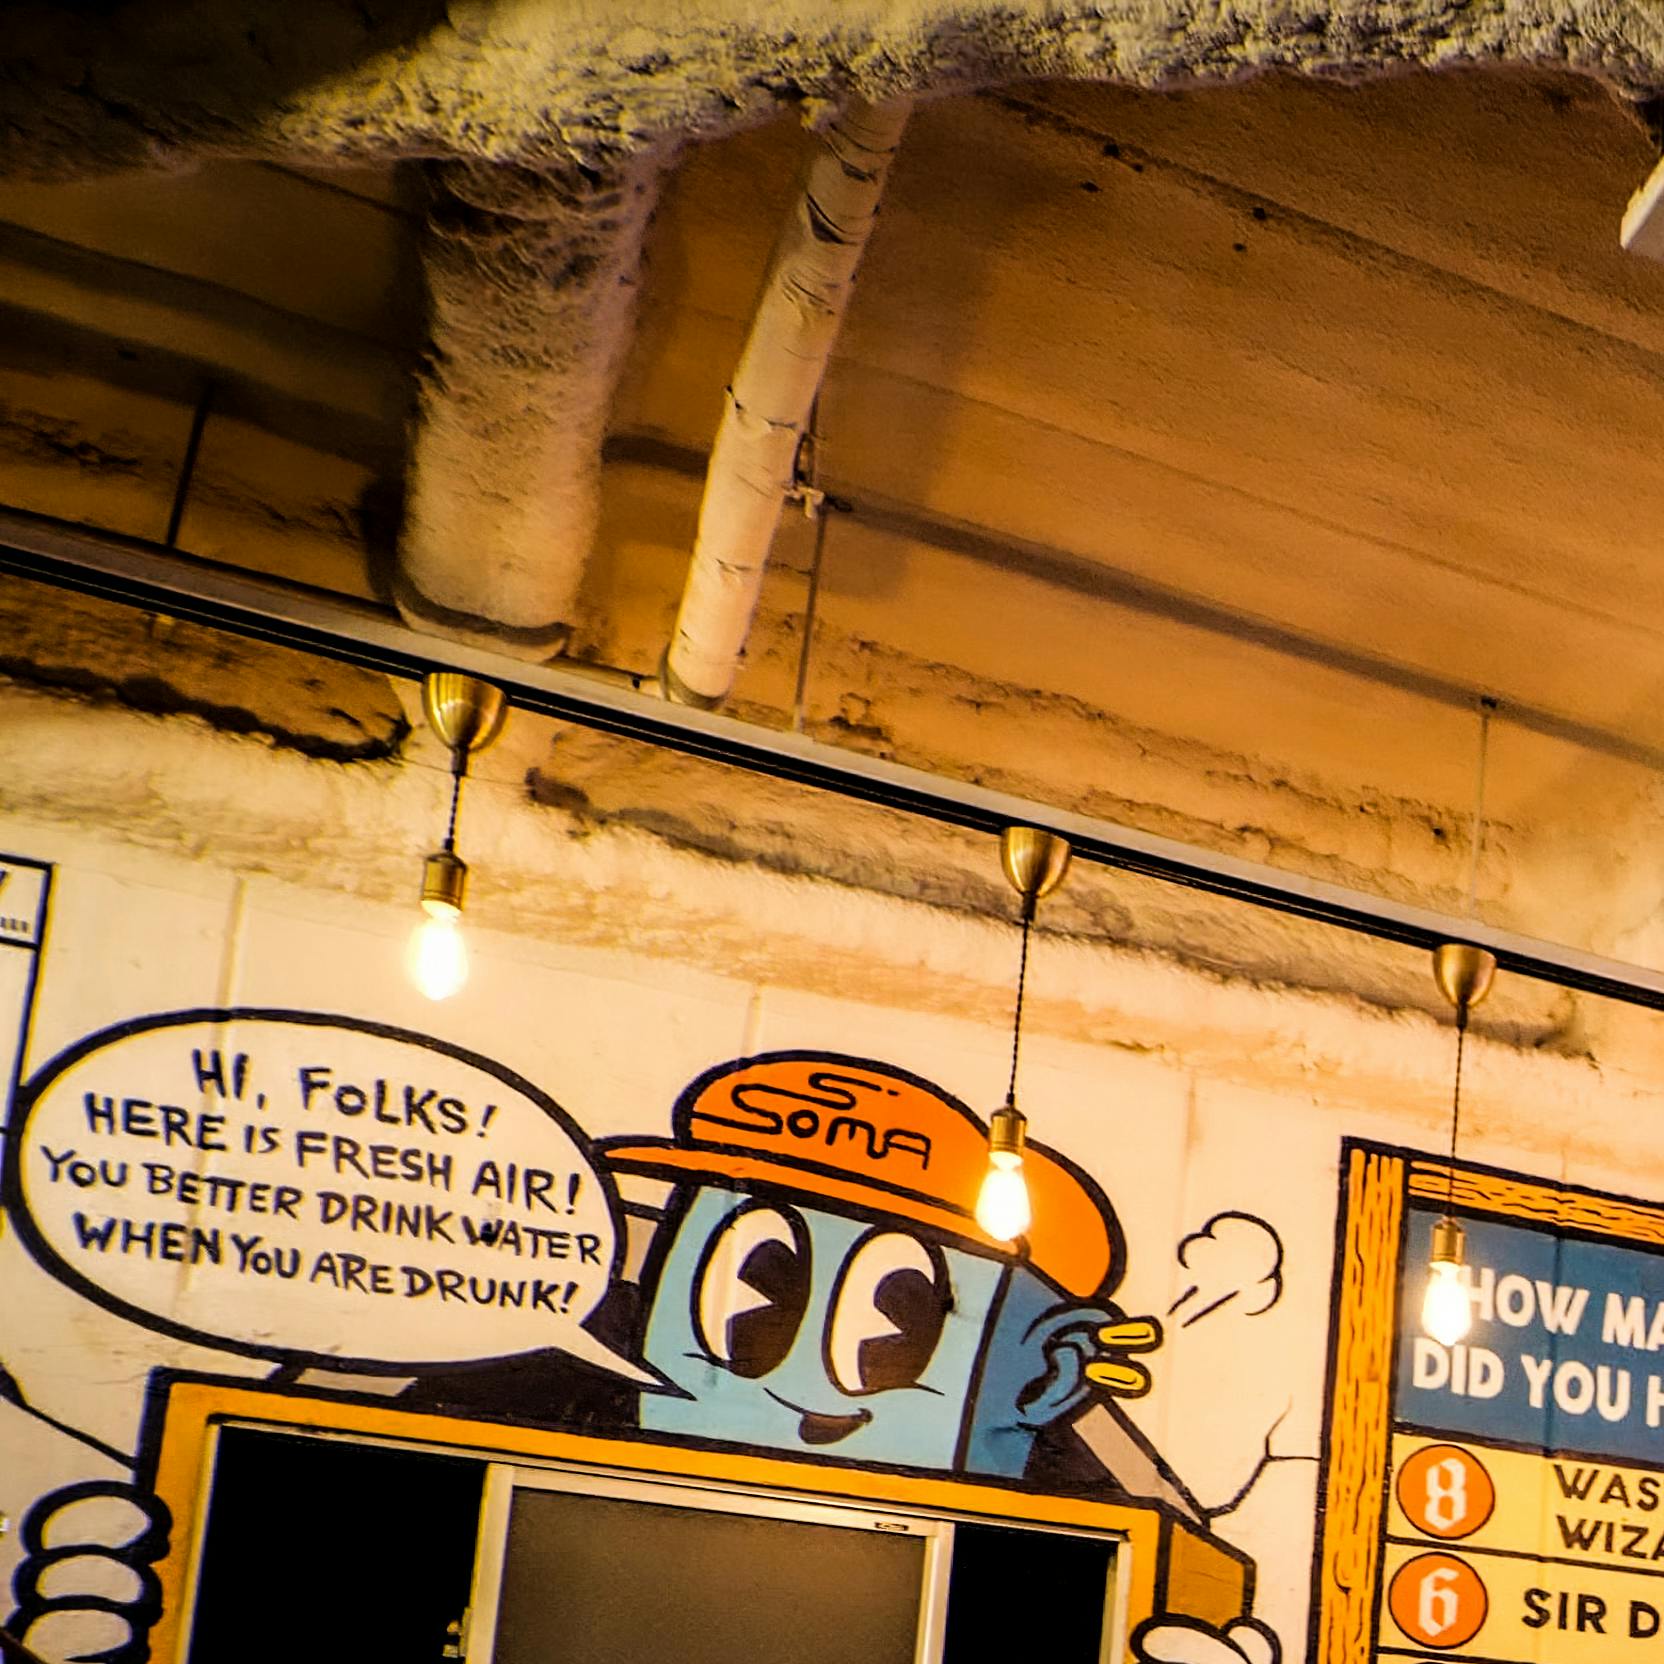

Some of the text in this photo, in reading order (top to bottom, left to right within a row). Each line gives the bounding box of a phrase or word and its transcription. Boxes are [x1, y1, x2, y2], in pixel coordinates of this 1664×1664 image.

[192, 1049, 498, 1137] HI, FOLKS!
[690, 1072, 931, 1170] SOMA
[85, 1092, 581, 1215] HERE IS FRESH AIR!
[41, 1144, 602, 1266] YOU BETTER DRINK WATER
[72, 1211, 579, 1314] WHEN YOU ARE DRUNK!
[1459, 1264, 1590, 1335] HOW
[1412, 1342, 1503, 1399] DID
[1520, 1354, 1631, 1423] YOU
[1424, 1458, 1467, 1531] 8
[1418, 1567, 1460, 1638] 6
[1521, 1587, 1608, 1634] SIR
